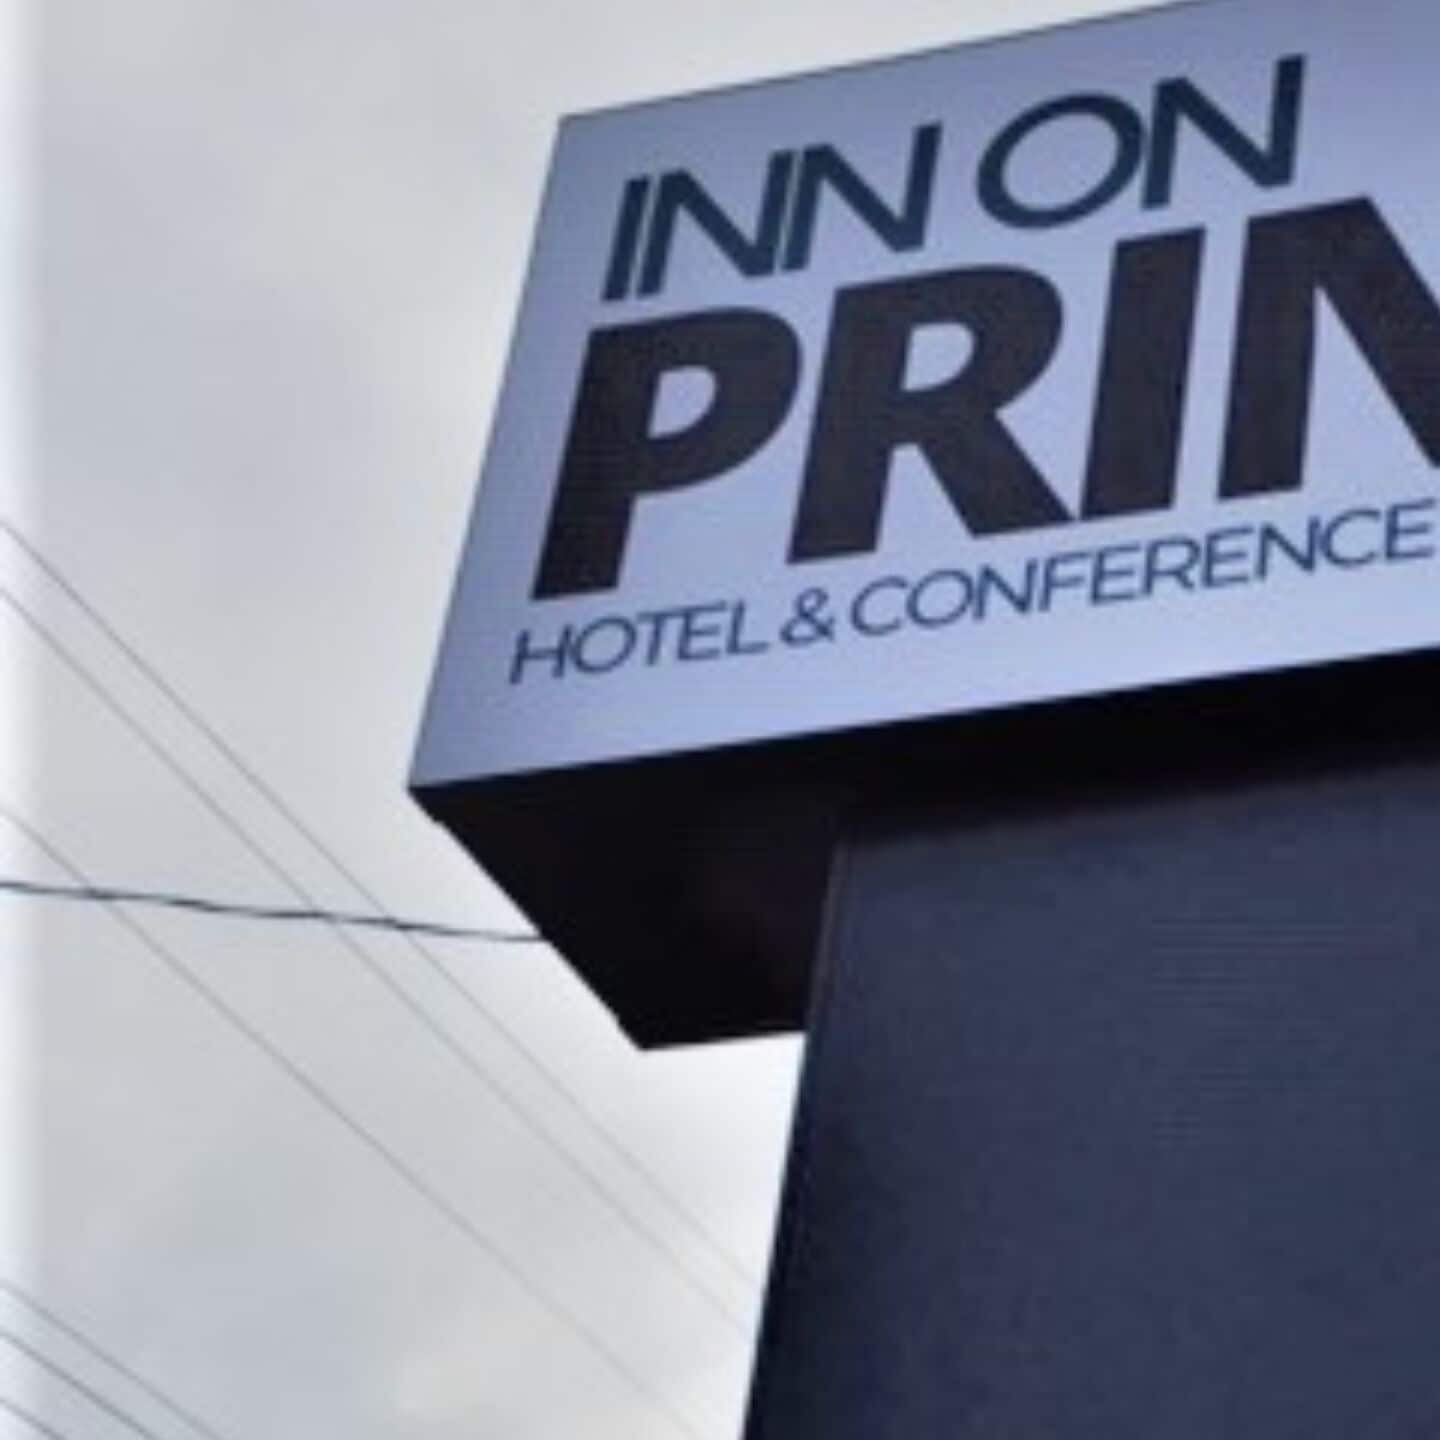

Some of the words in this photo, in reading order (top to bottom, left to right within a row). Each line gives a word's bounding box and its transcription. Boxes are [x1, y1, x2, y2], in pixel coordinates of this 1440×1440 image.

[602, 121, 942, 302] INN
[976, 55, 1307, 230] ON
[508, 598, 769, 685] HOTEL
[780, 587, 836, 645] &
[850, 498, 1438, 639] CONFERENCE
